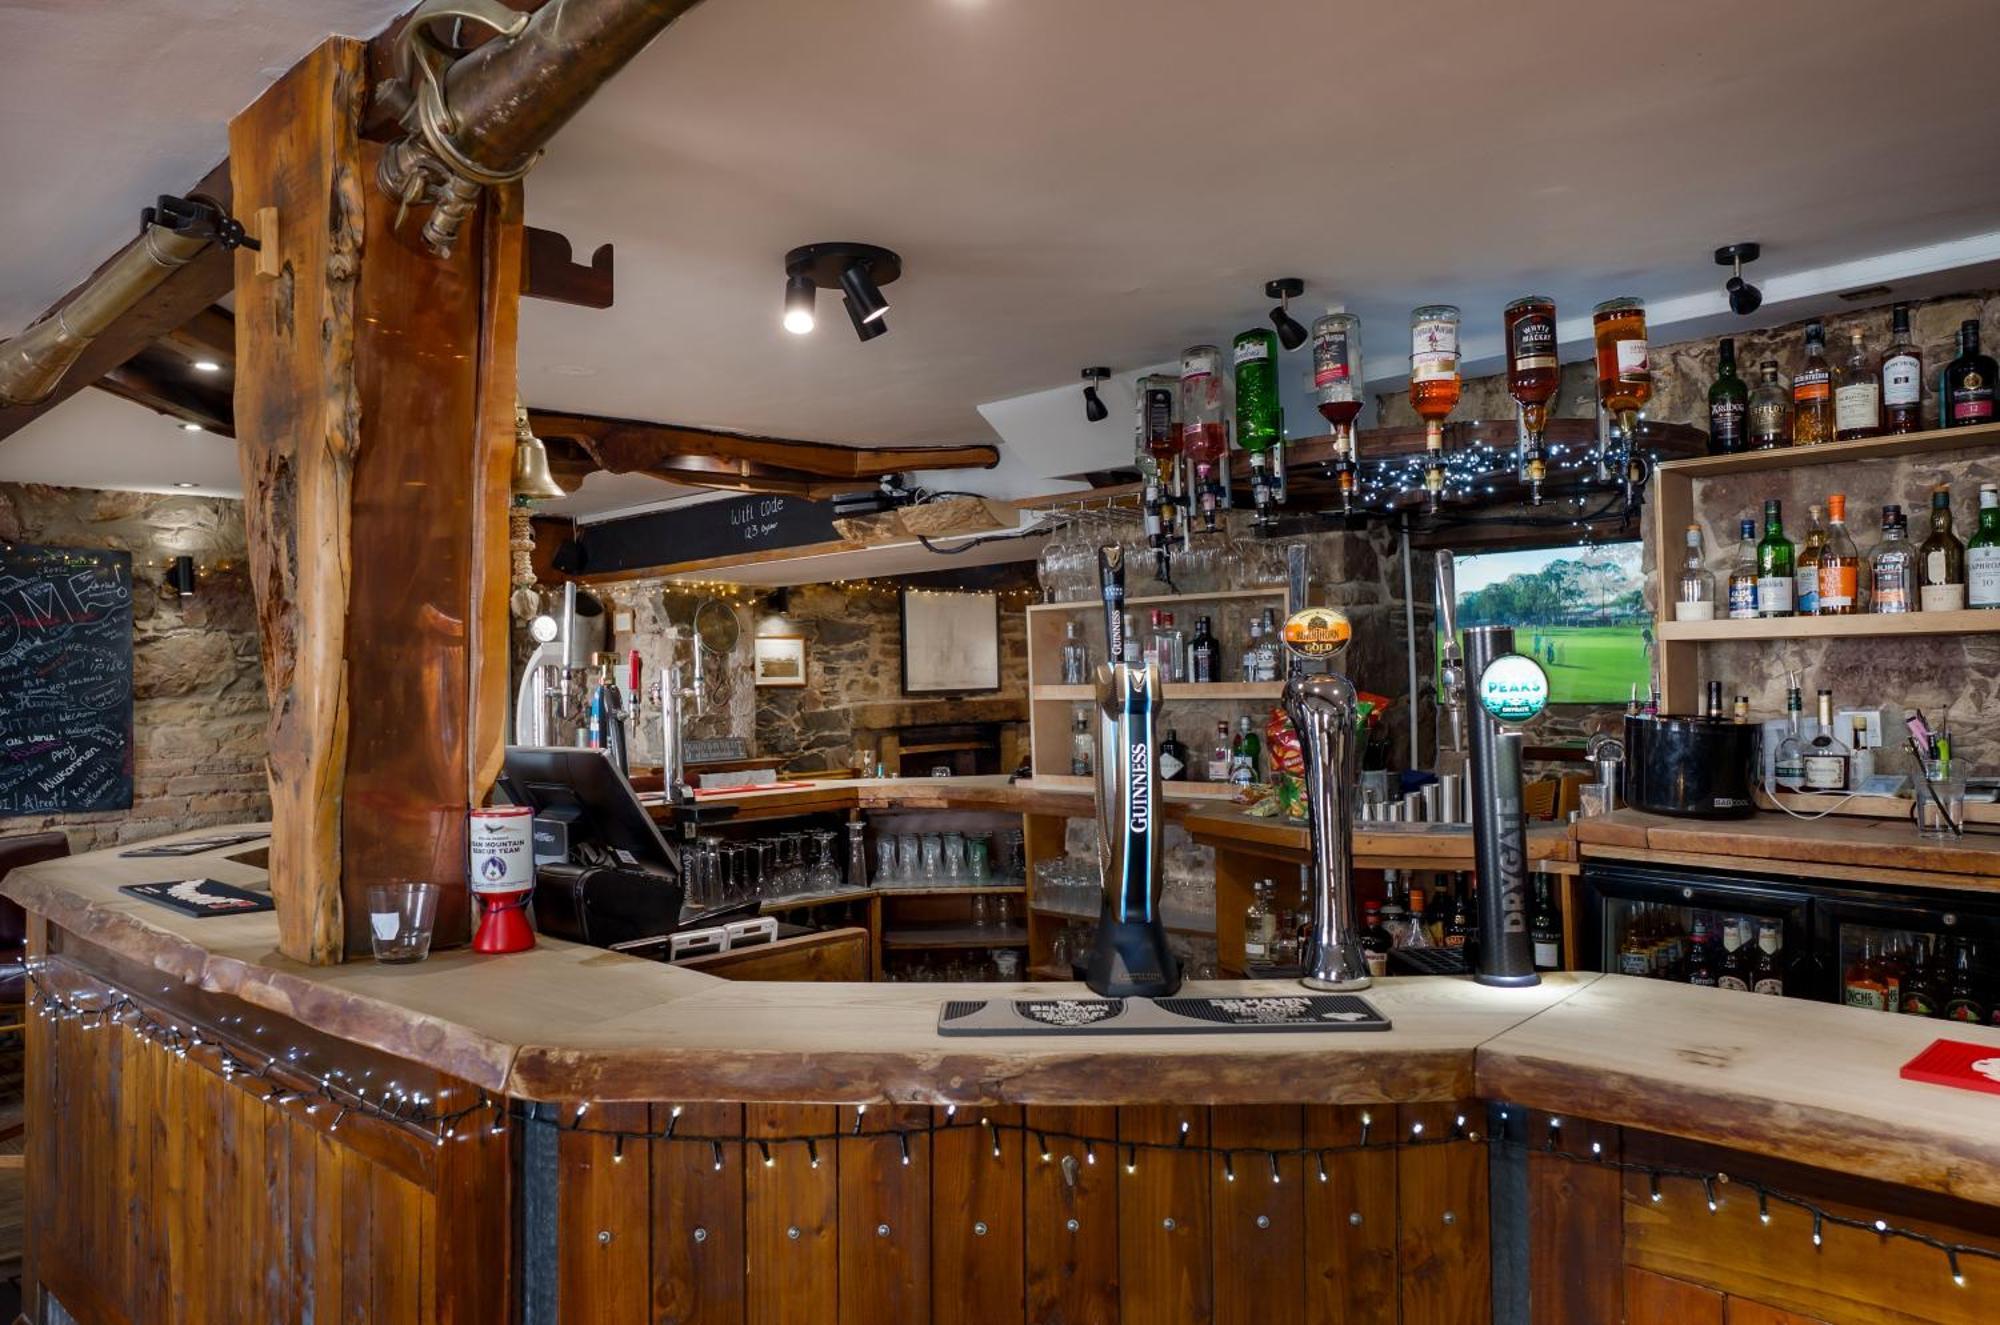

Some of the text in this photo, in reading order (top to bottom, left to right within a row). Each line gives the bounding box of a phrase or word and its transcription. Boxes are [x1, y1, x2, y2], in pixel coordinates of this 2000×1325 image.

[1523, 325, 1549, 334] WHYTE
[1874, 564, 1902, 573] JURA
[1112, 610, 1121, 656] GUINNESS
[1305, 642, 1333, 653] GOLD
[1130, 743, 1148, 833] GUINNESS
[484, 840, 525, 848] MOUNTAIN
[1497, 797, 1527, 933] DRYGATE
